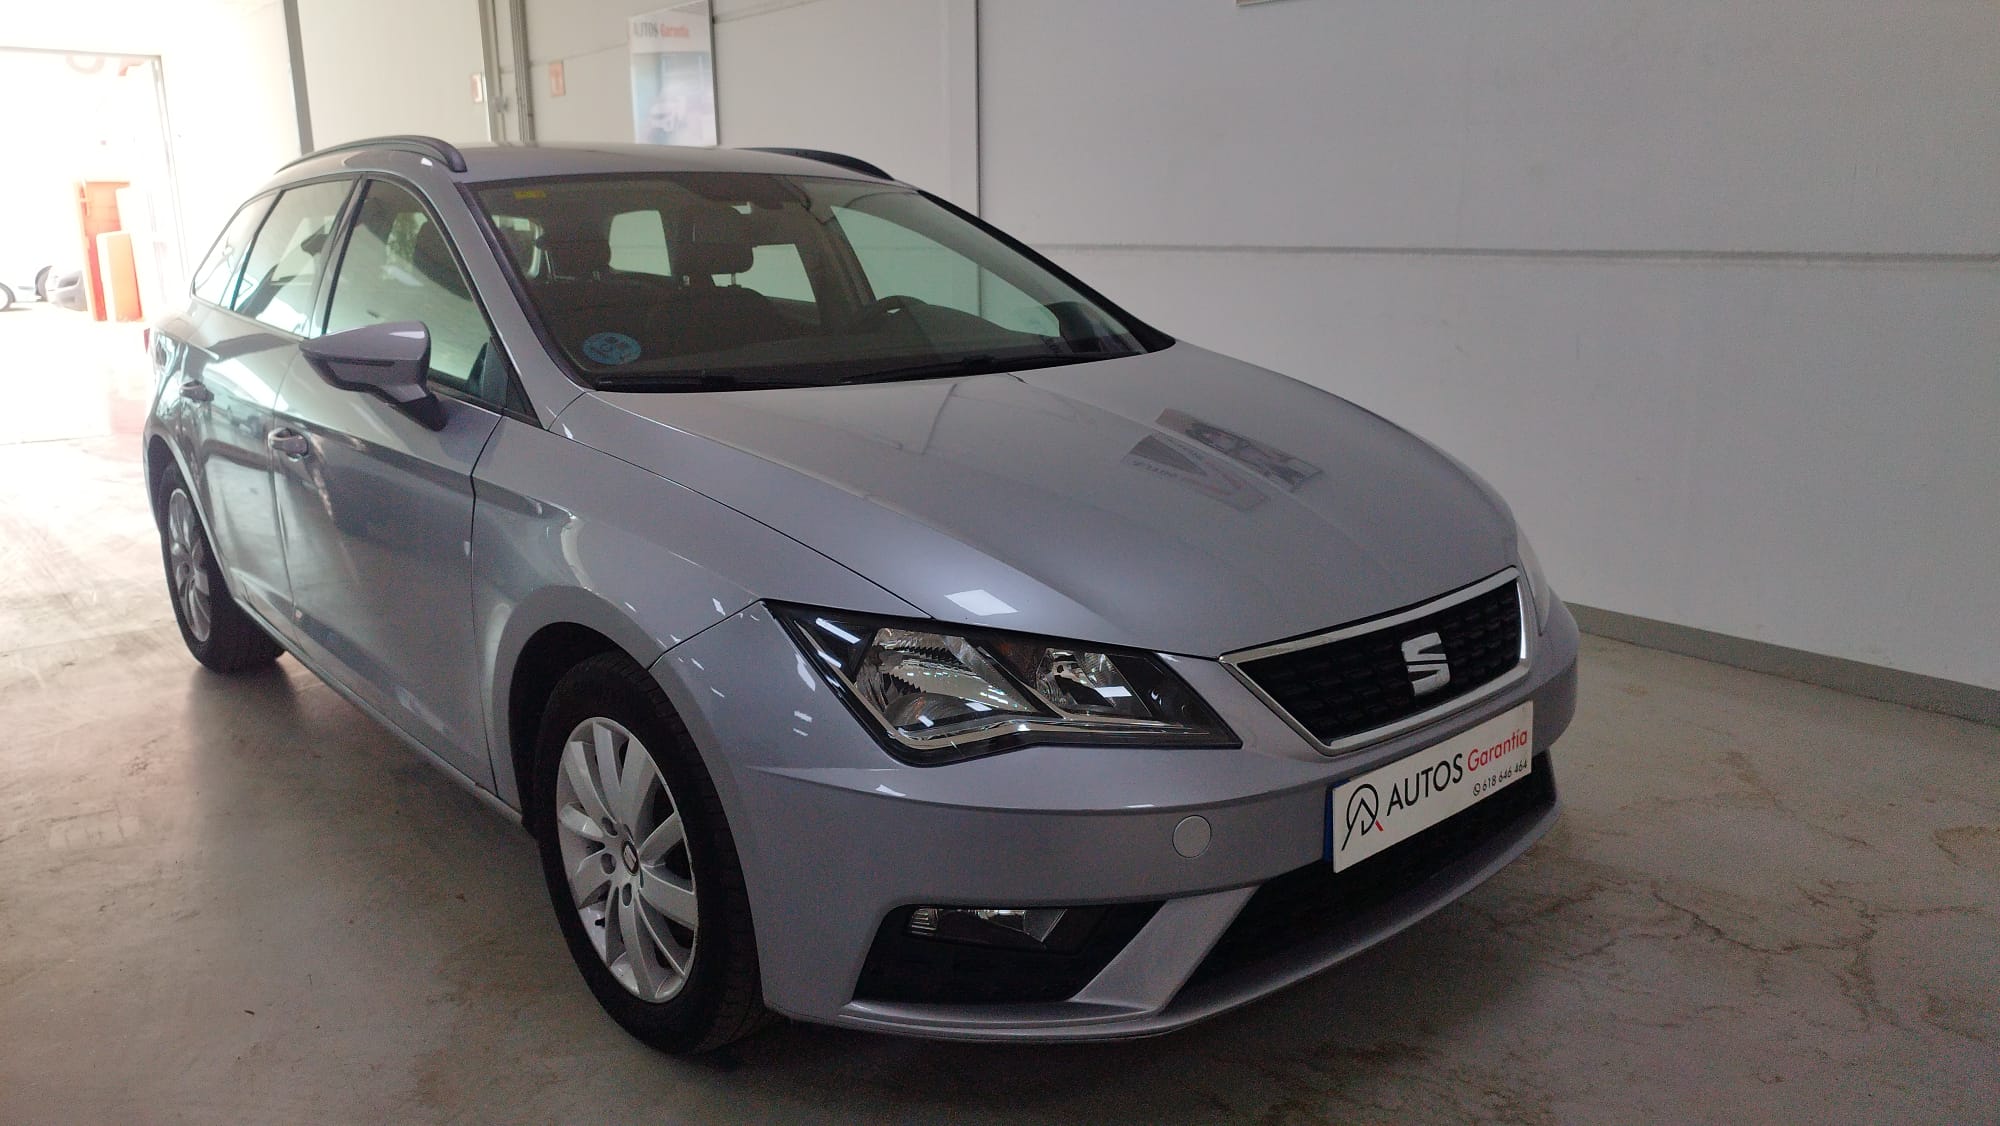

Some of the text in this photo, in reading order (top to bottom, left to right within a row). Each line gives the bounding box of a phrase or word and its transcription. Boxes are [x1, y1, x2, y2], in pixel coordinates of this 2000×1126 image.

[1387, 729, 1527, 816] AUTOS Garantía
[1482, 759, 1528, 791] 618 646 464
